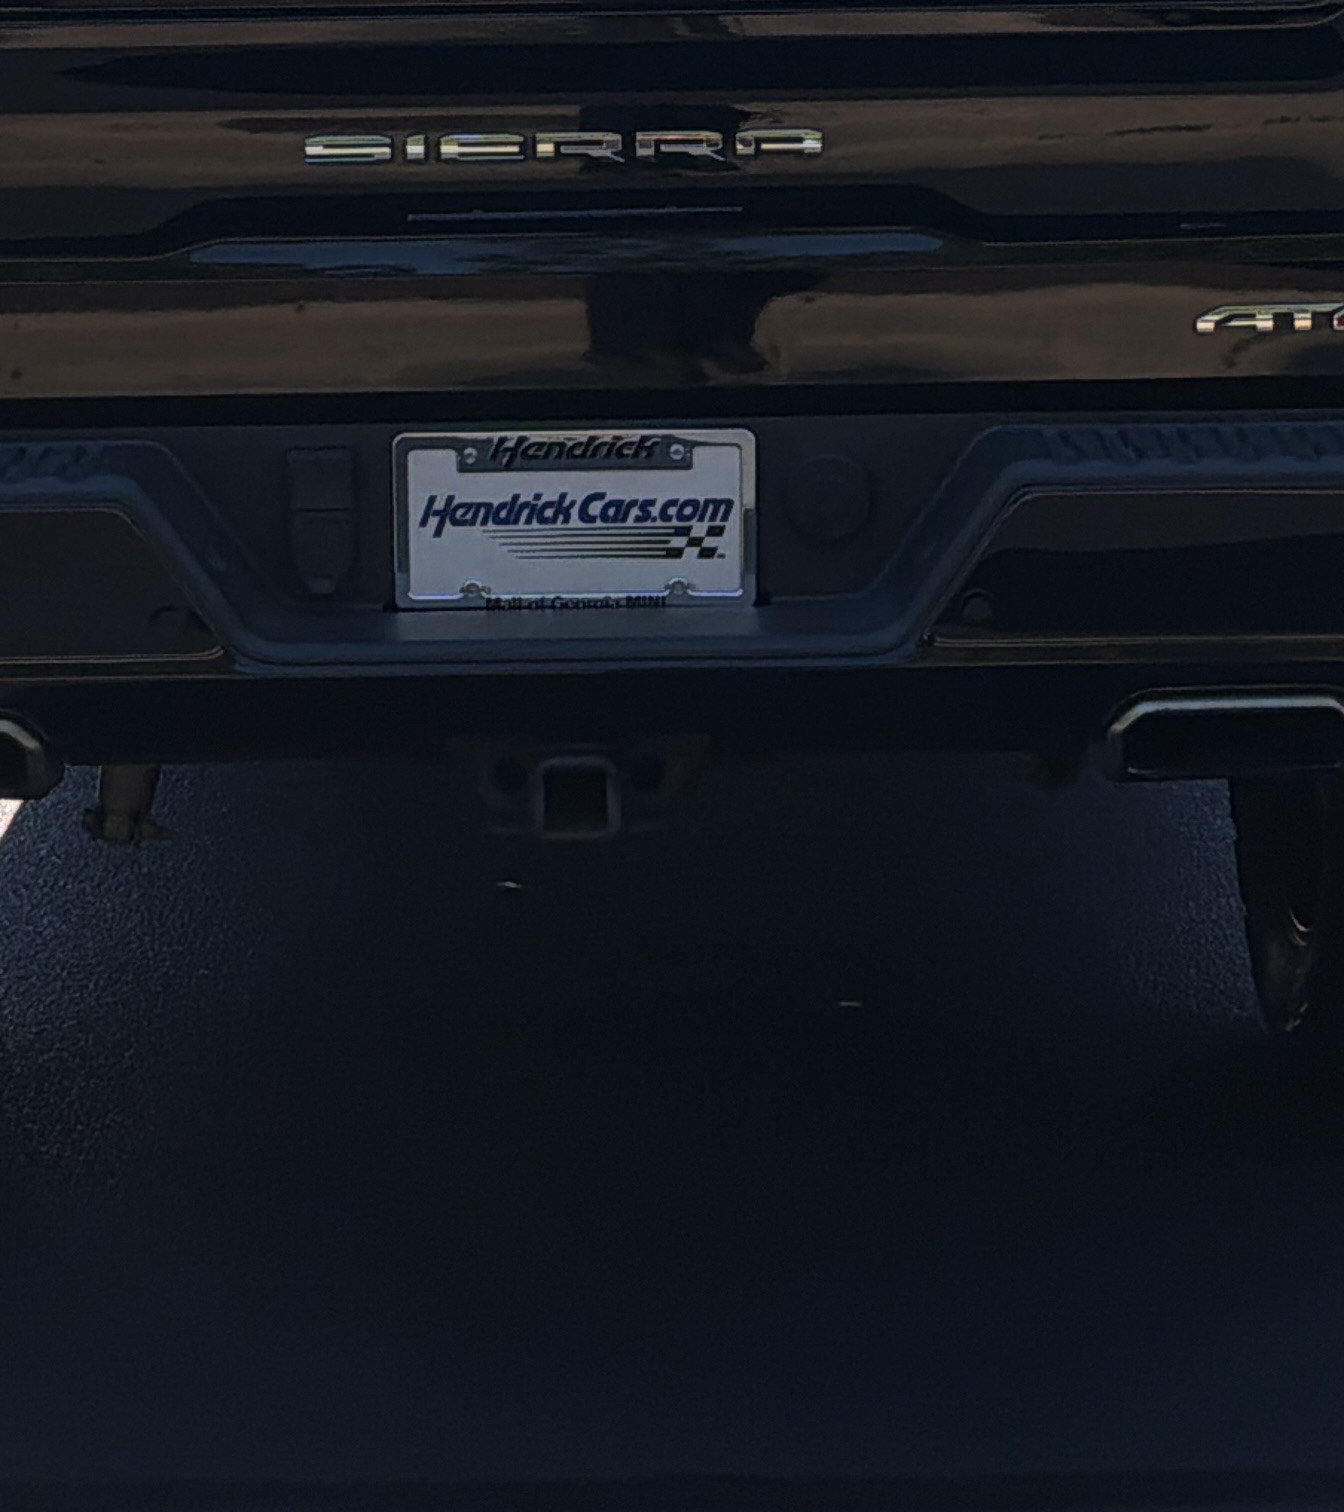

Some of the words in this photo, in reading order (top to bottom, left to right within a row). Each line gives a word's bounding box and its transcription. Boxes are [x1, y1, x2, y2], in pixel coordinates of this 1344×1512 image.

[303, 128, 826, 164] SIERRA
[488, 434, 662, 468] Hendrick
[418, 491, 736, 538] HendrickCars.com
